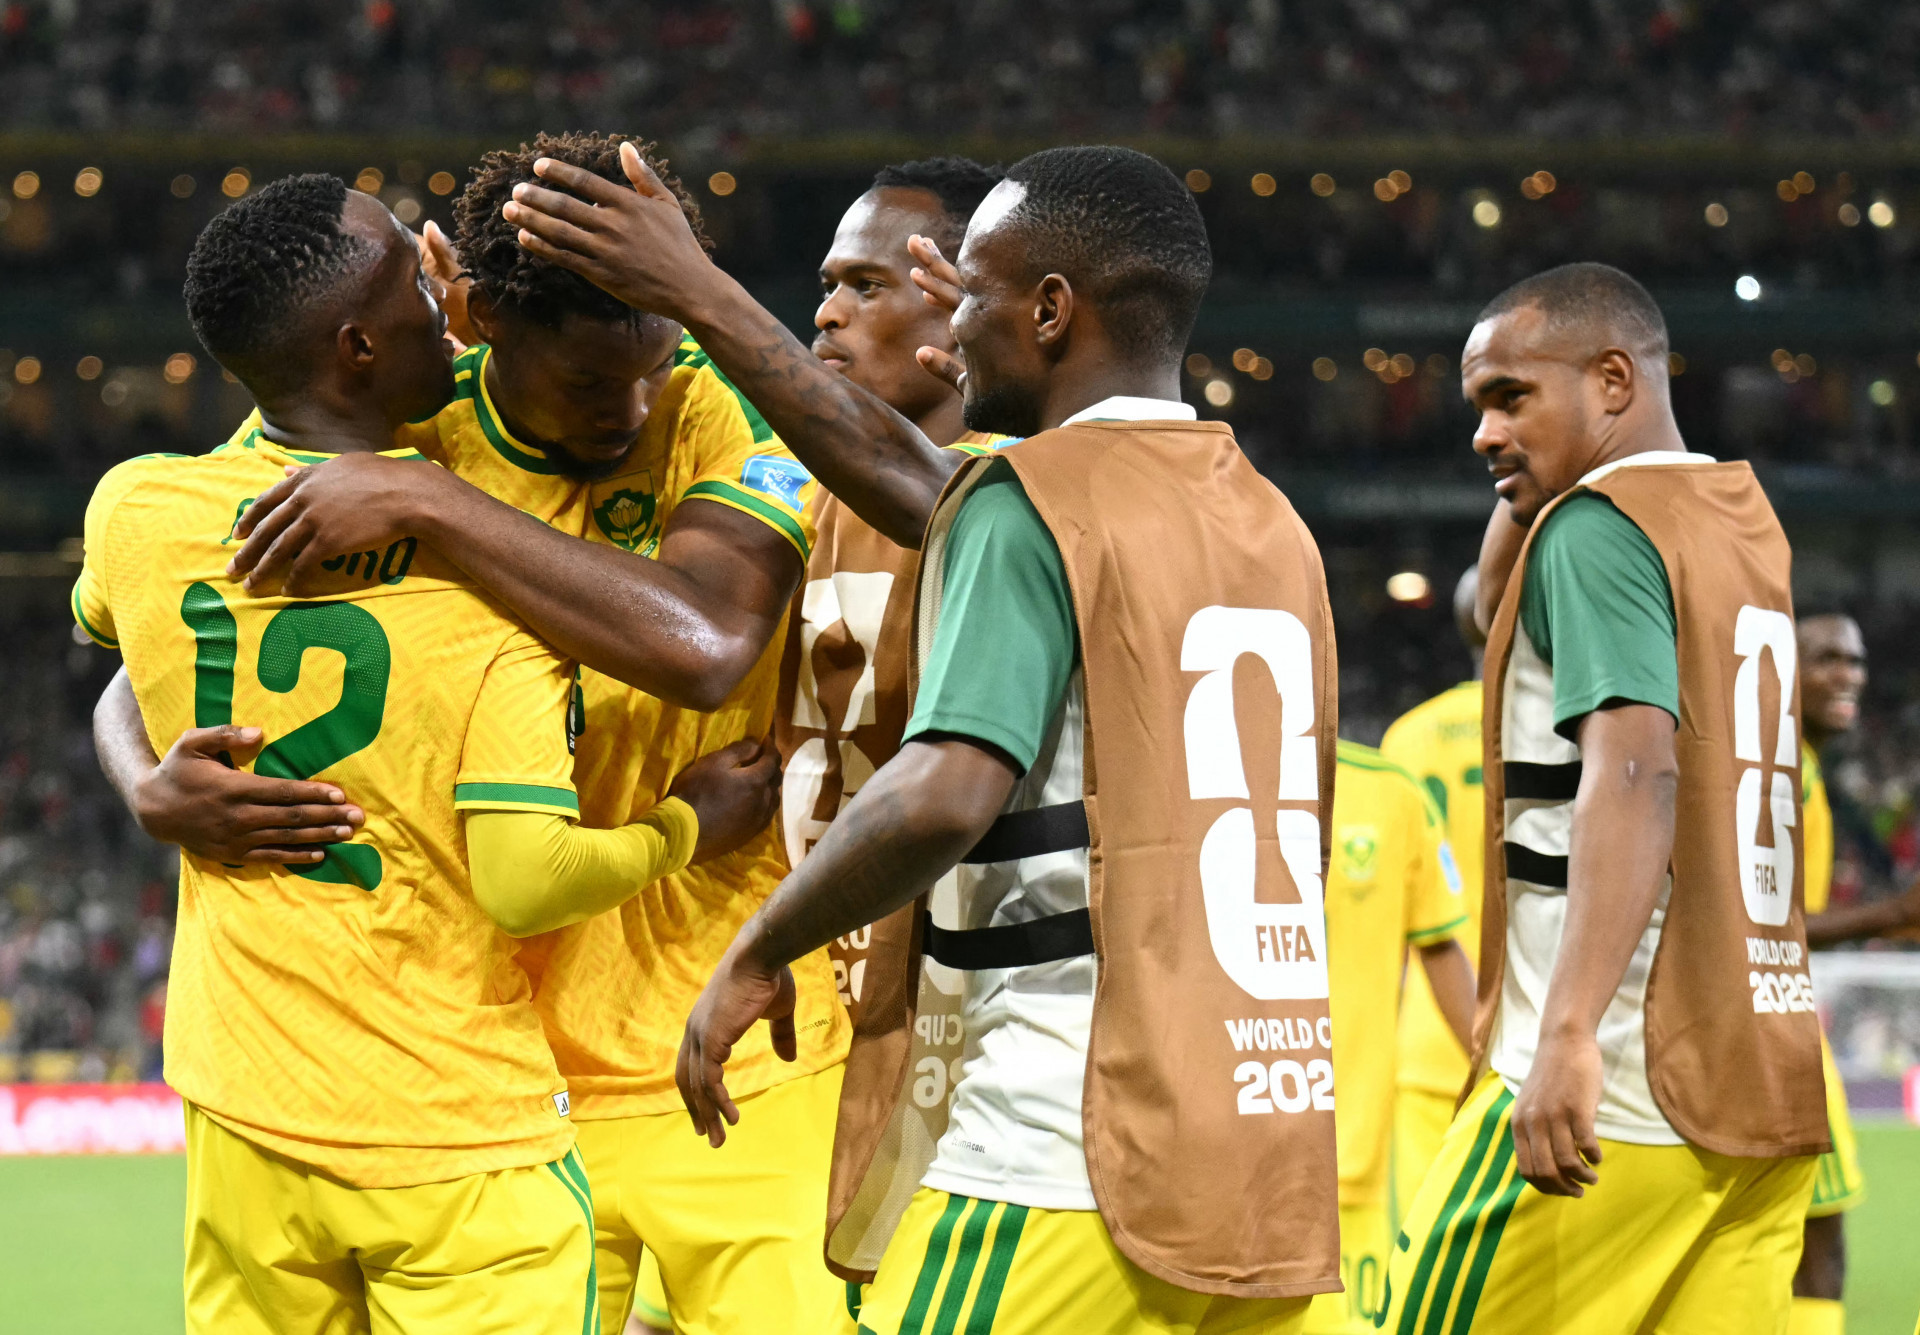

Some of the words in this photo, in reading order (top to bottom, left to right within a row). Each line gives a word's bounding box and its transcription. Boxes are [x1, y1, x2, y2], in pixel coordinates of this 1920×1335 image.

[181, 581, 391, 891] 12
[1755, 863, 1777, 896] FIFA
[1255, 925, 1316, 962] FIFA
[1780, 941, 1802, 966] CUP
[1749, 971, 1816, 1014] 2026
[1224, 1018, 1314, 1051] WORLD
[1315, 1017, 1332, 1049] C
